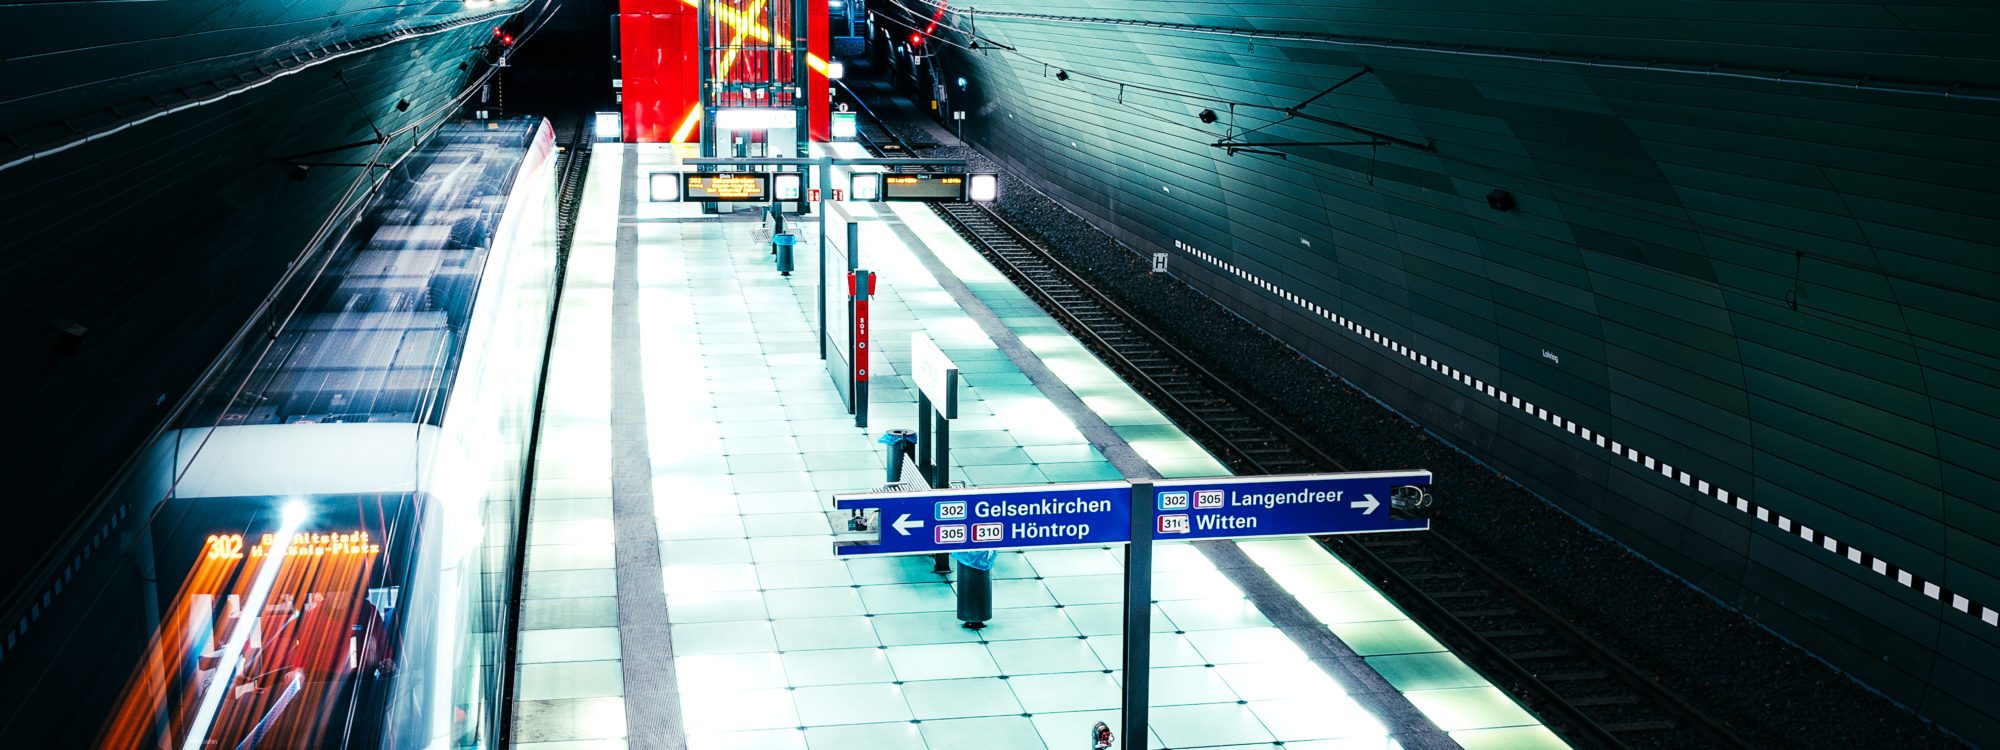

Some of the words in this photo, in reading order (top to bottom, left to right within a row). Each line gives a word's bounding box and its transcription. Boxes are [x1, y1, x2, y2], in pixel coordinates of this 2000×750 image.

[1155, 256, 1165, 269] H
[941, 506, 964, 516] 302
[974, 497, 1112, 518] Gelsenkirchen
[1164, 496, 1186, 506] 302
[1199, 494, 1221, 504] 305
[1231, 488, 1344, 509] Langendreer
[941, 529, 964, 539] 305
[978, 527, 1000, 538] 310
[1011, 522, 1090, 540] Höntrop
[1196, 514, 1257, 530] Witten
[207, 533, 243, 559] 302
[251, 543, 380, 557] H.önig-Platz
